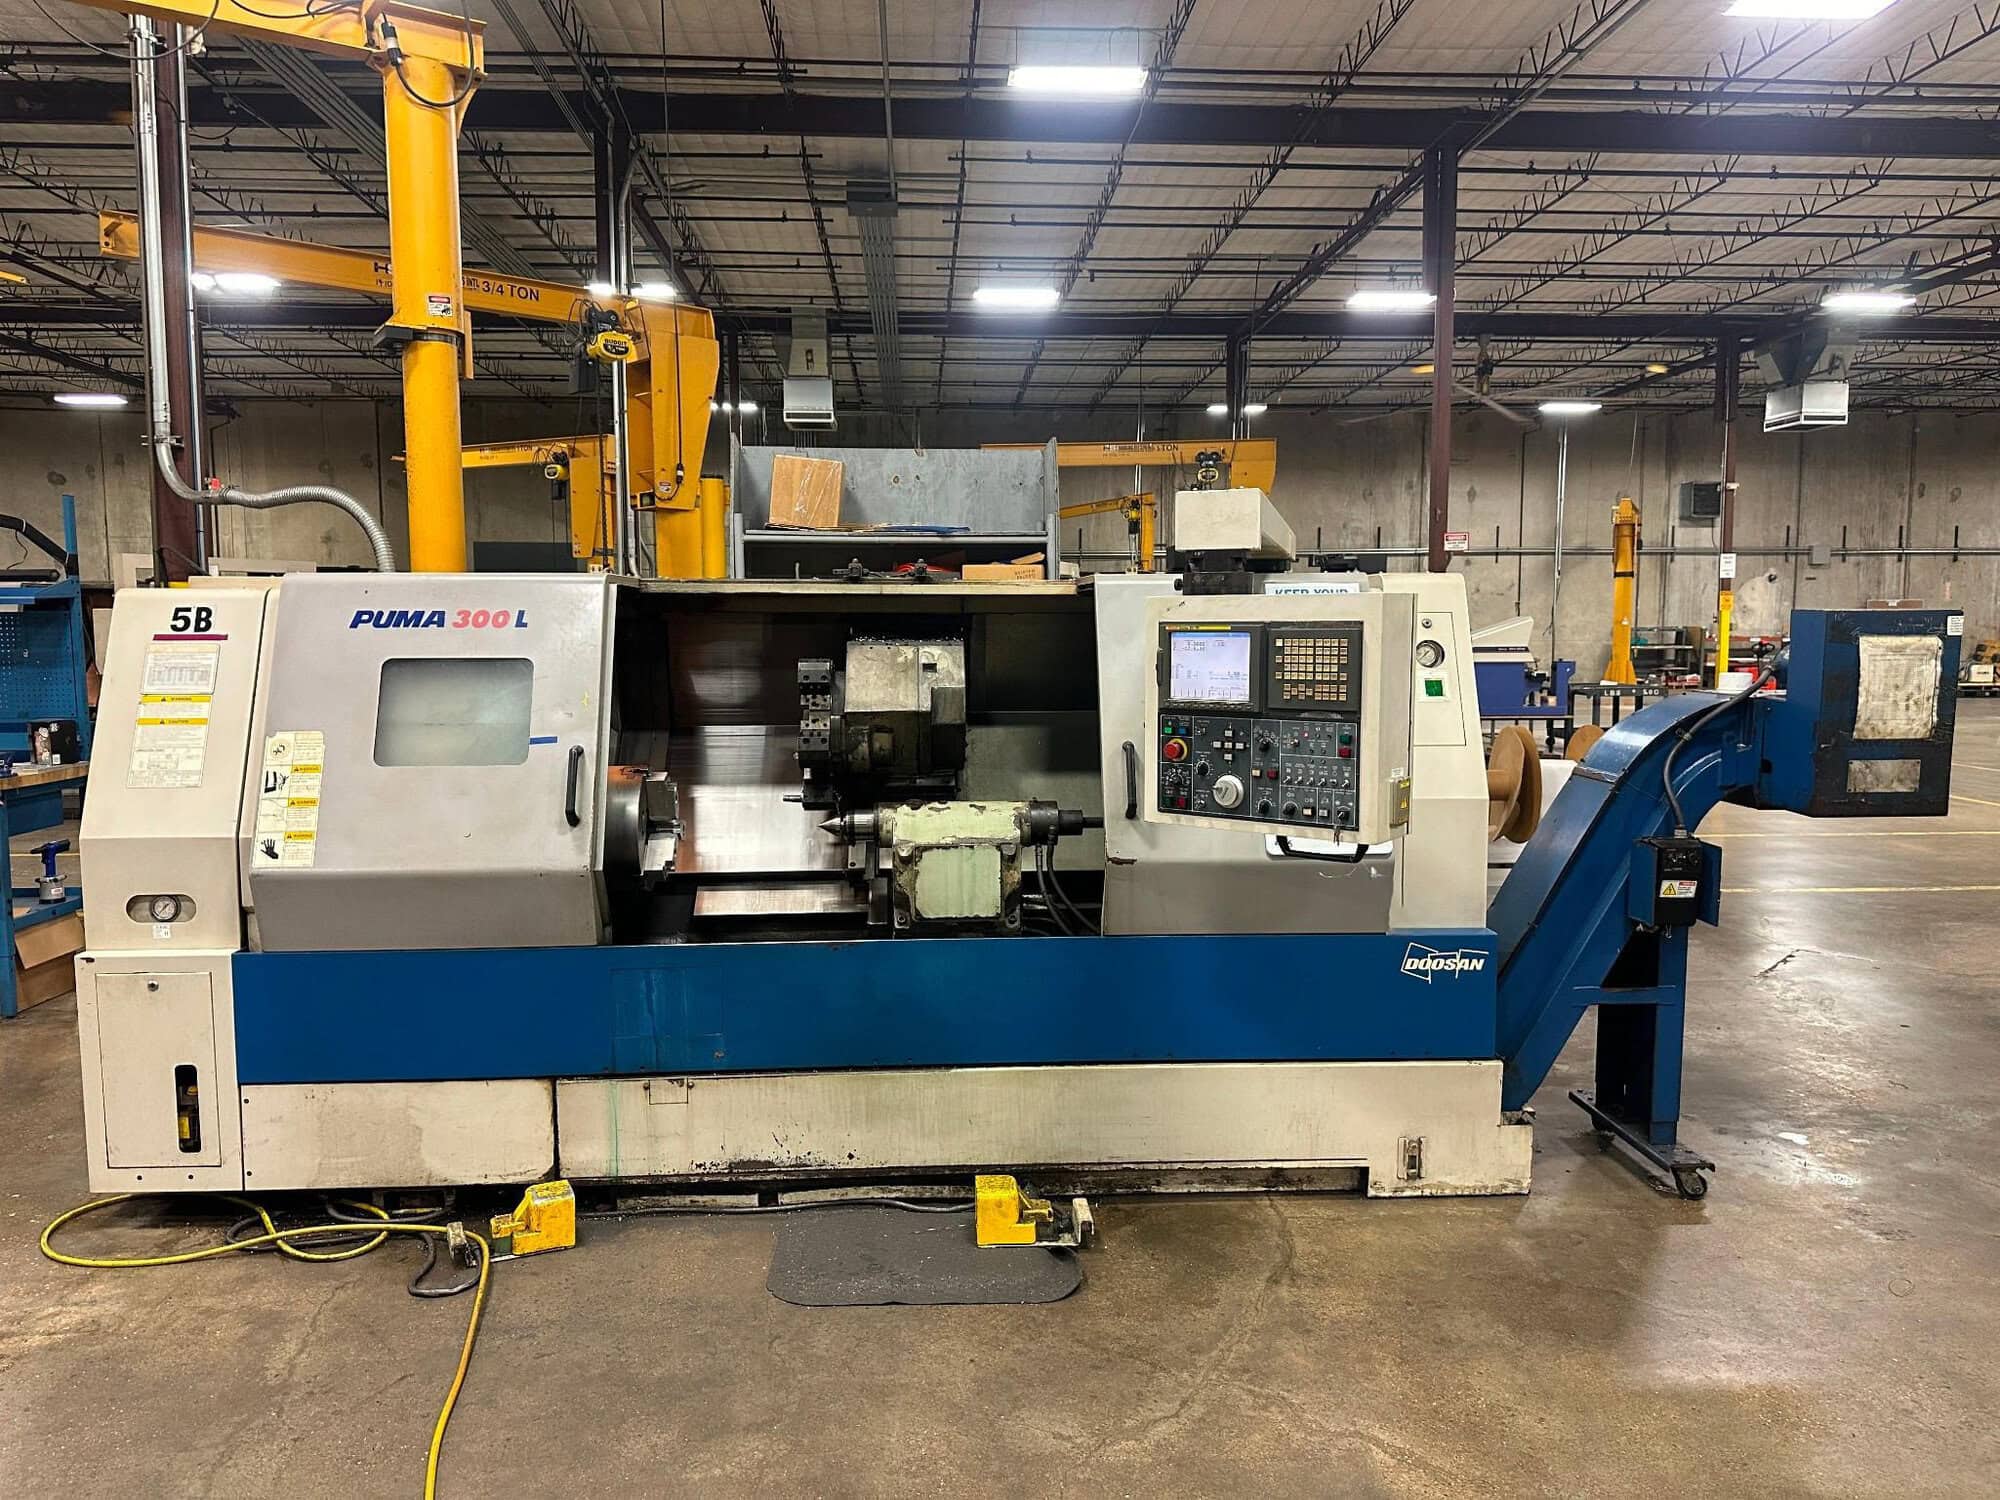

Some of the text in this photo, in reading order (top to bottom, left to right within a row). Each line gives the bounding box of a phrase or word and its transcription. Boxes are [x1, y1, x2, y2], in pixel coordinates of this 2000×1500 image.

[482, 280, 504, 296] 3/4
[507, 284, 540, 301] TON
[170, 606, 213, 632] 5B
[349, 609, 528, 629] PUMA 300 L
[1404, 958, 1486, 971] DOOSAN
